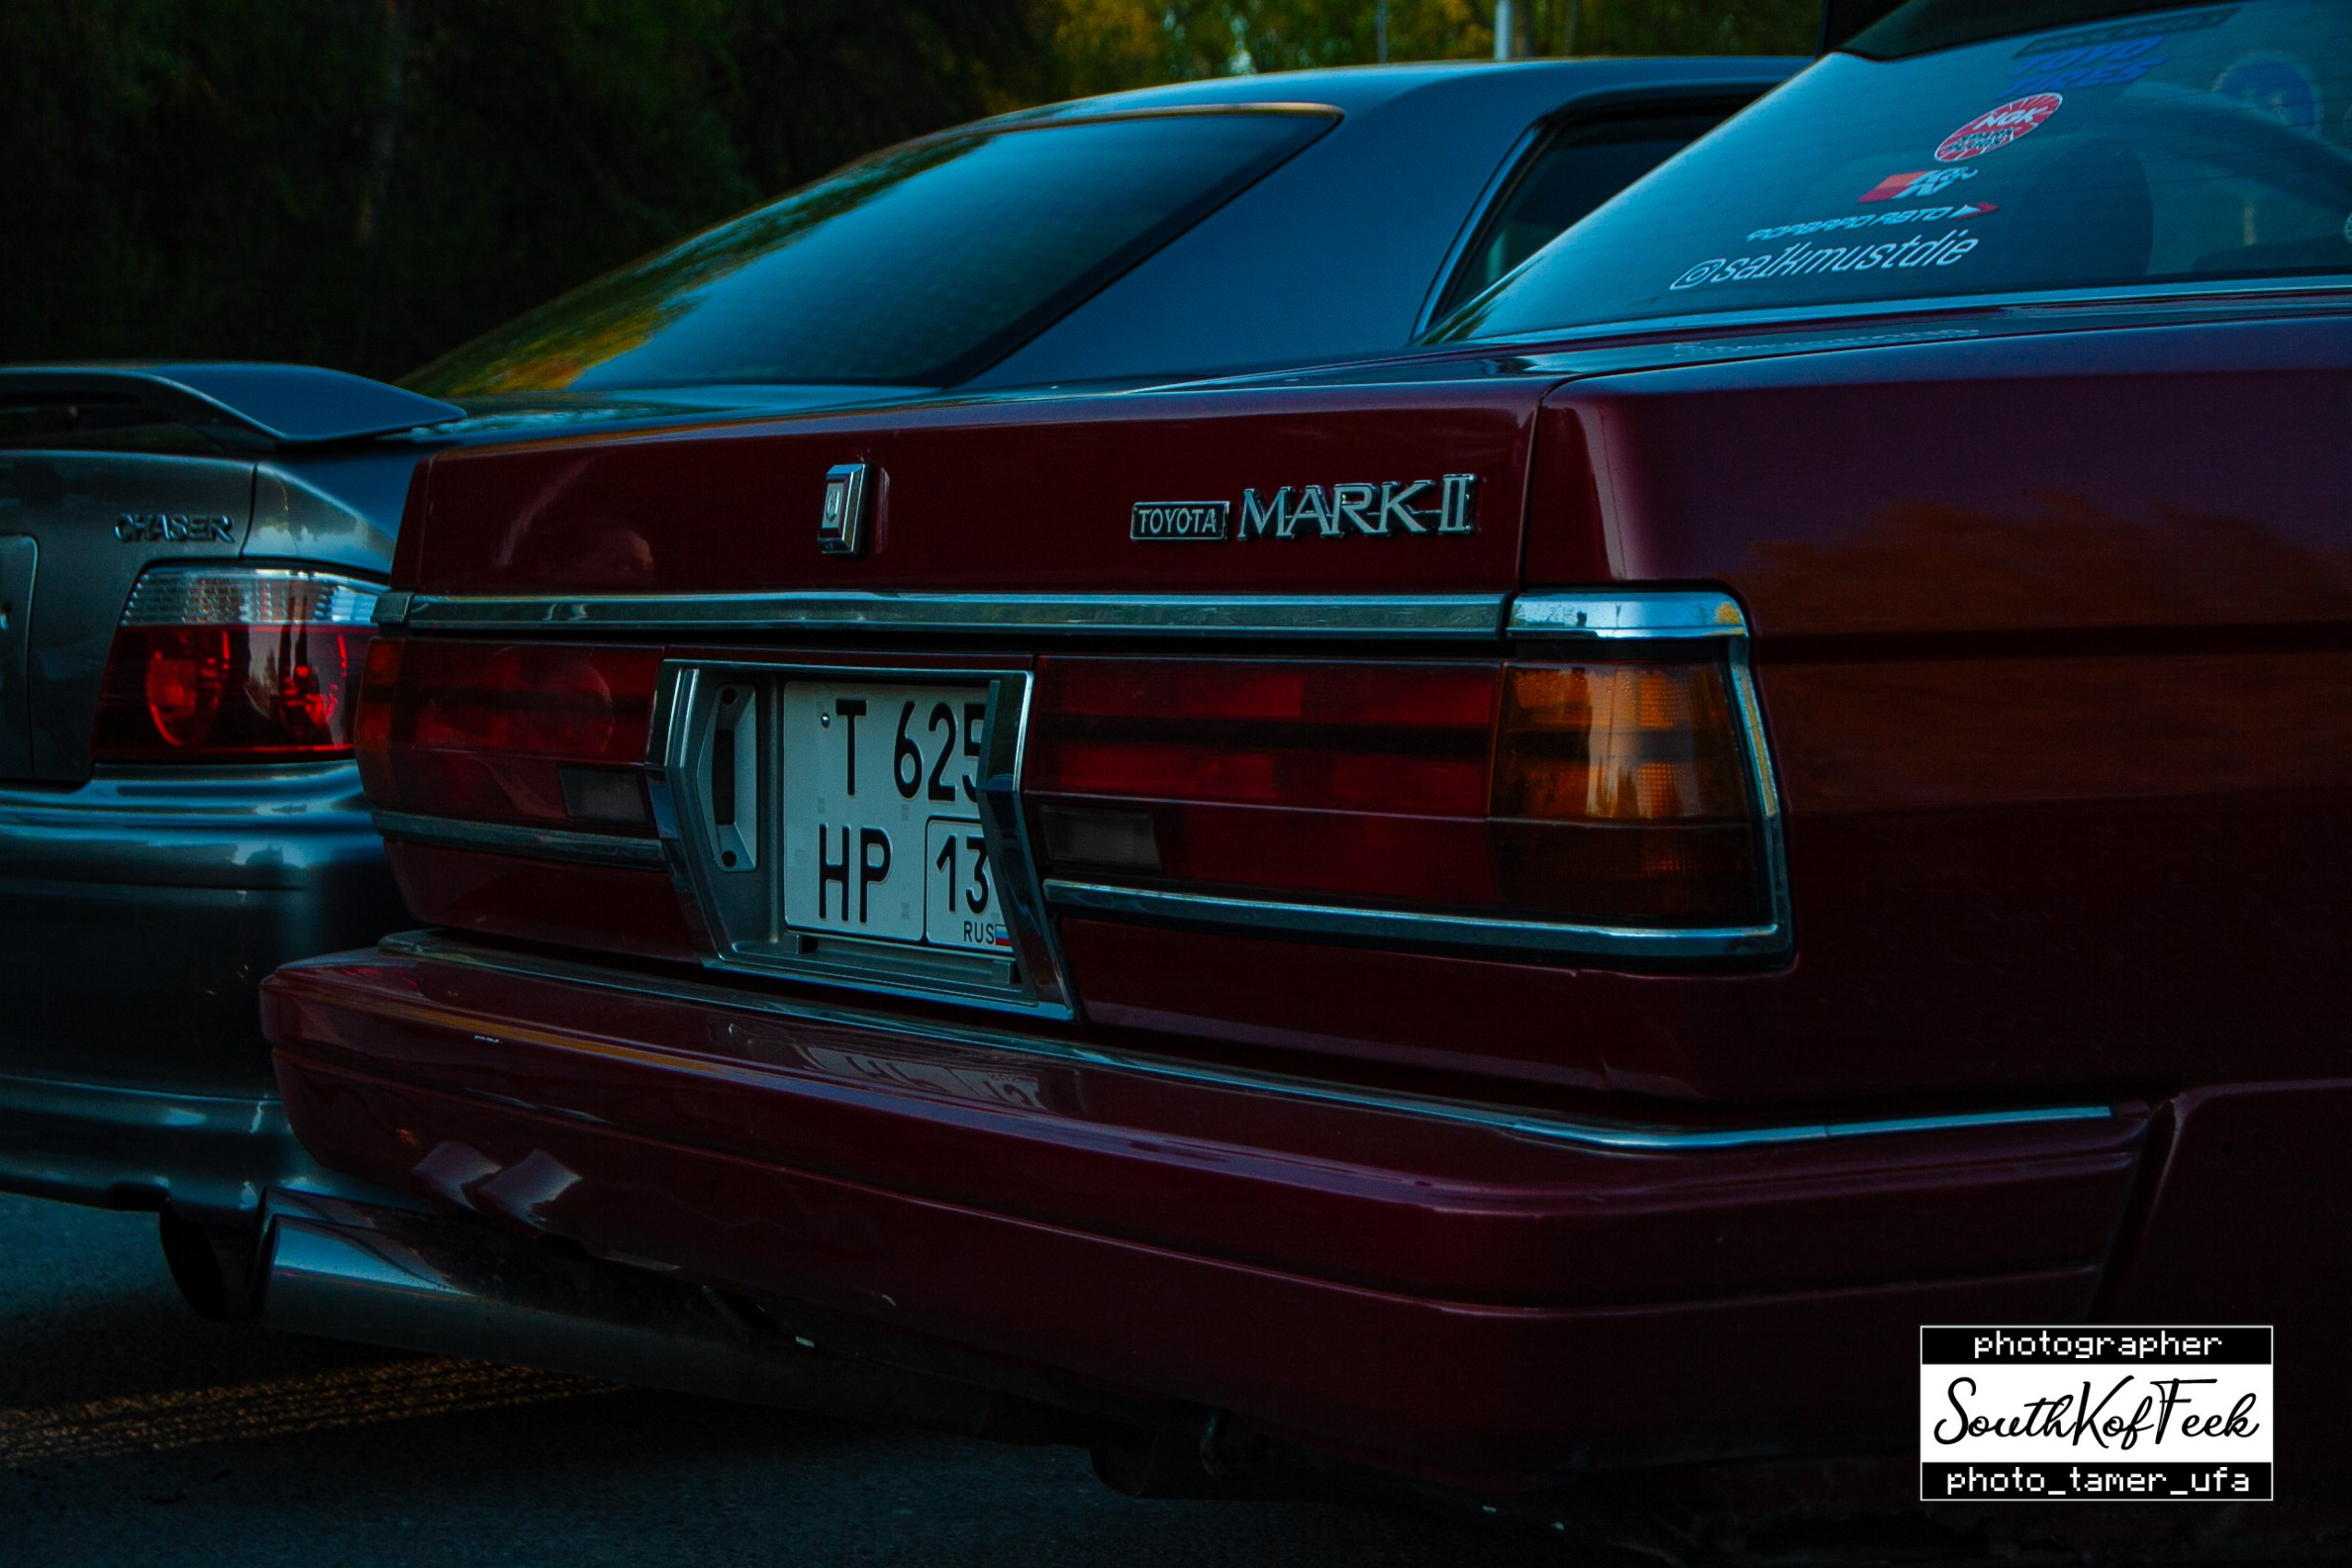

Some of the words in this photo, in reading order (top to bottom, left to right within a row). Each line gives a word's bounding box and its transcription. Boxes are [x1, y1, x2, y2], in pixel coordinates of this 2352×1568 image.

[1973, 106, 2049, 130] NGK
[1138, 508, 1218, 536] TOYOTA
[1237, 479, 1434, 541] MARK
[113, 514, 235, 543] CHASER
[894, 701, 987, 803] 625
[963, 921, 995, 945] RUS
